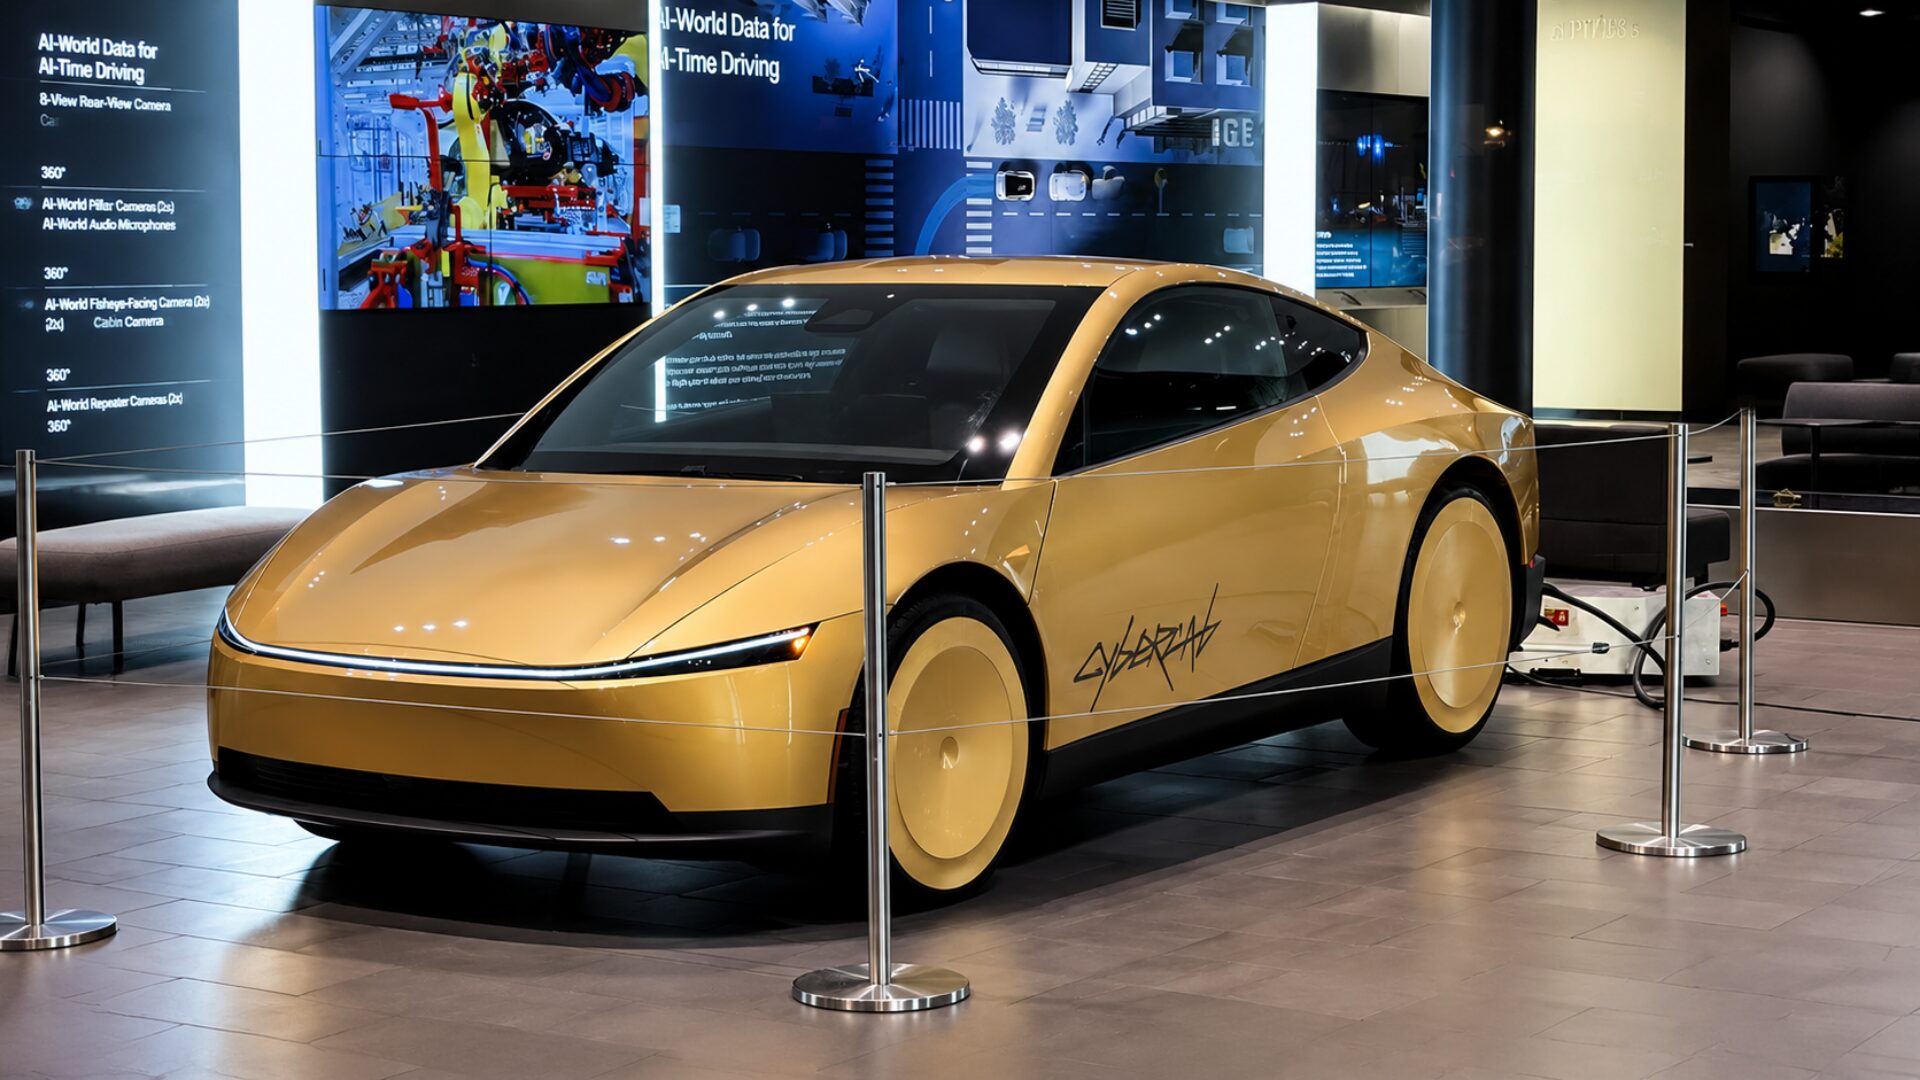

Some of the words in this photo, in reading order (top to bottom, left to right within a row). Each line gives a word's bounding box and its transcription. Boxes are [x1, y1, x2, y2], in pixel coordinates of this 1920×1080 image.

[731, 12, 770, 40] Data
[772, 16, 796, 42] for
[38, 33, 100, 55] AI-World
[103, 38, 136, 58] Data
[138, 41, 159, 60] for
[38, 56, 93, 78] AI-Time
[95, 61, 145, 86] Driving
[720, 50, 780, 84] Driving
[39, 92, 78, 108] 8-View
[42, 197, 87, 211] AI-World
[42, 217, 88, 231] AI-World
[89, 218, 117, 231] Audio
[117, 219, 176, 233] Microphones
[44, 298, 88, 311] AI-World
[46, 399, 90, 413] AI-World
